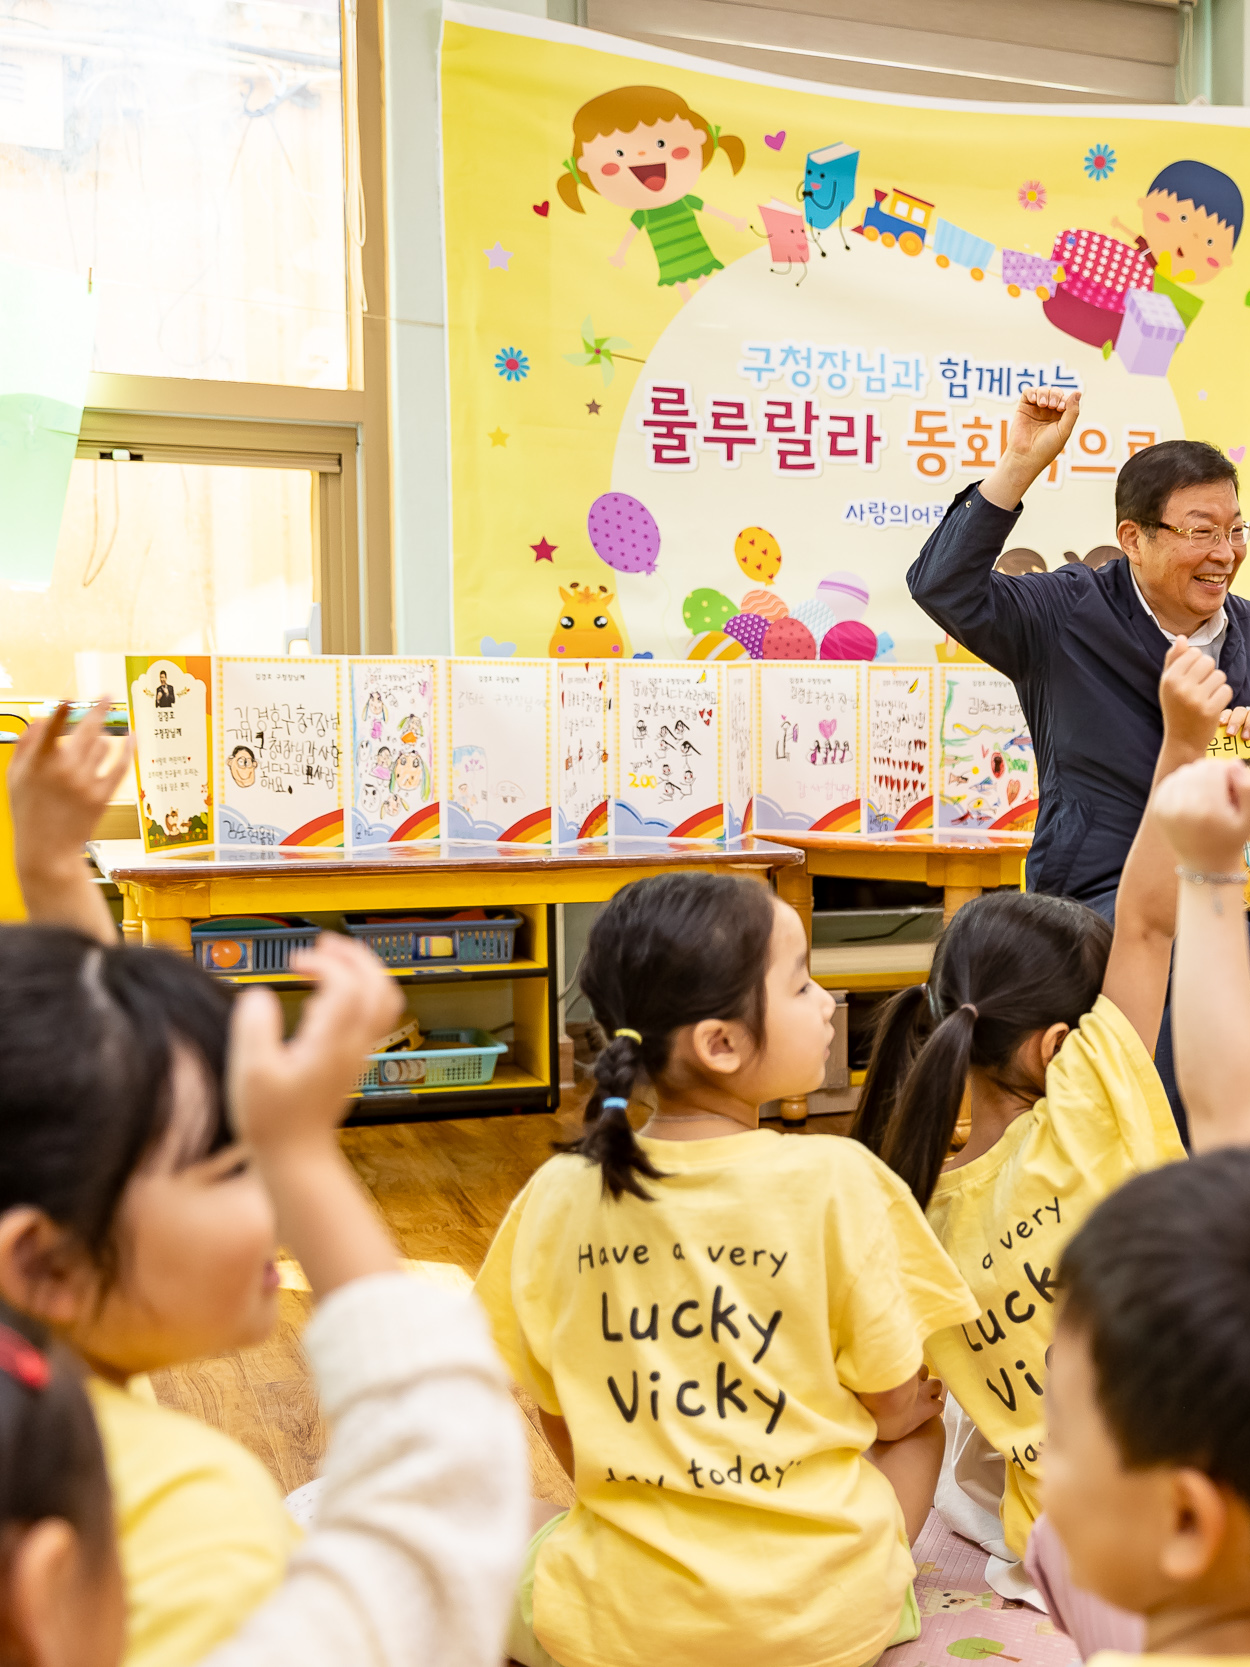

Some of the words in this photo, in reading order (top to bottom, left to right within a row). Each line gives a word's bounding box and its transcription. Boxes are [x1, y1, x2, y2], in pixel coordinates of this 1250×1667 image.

[743, 345, 925, 394] 구청장님과
[643, 386, 882, 470] 룰루랄라
[1207, 734, 1238, 756] 우리
[1000, 1196, 1061, 1251] very
[578, 1242, 650, 1274] Have
[673, 1242, 686, 1260] a
[707, 1247, 789, 1278] very
[601, 1285, 783, 1364] Lucky
[961, 1262, 1061, 1352] Luck
[606, 1361, 787, 1435] Vicky
